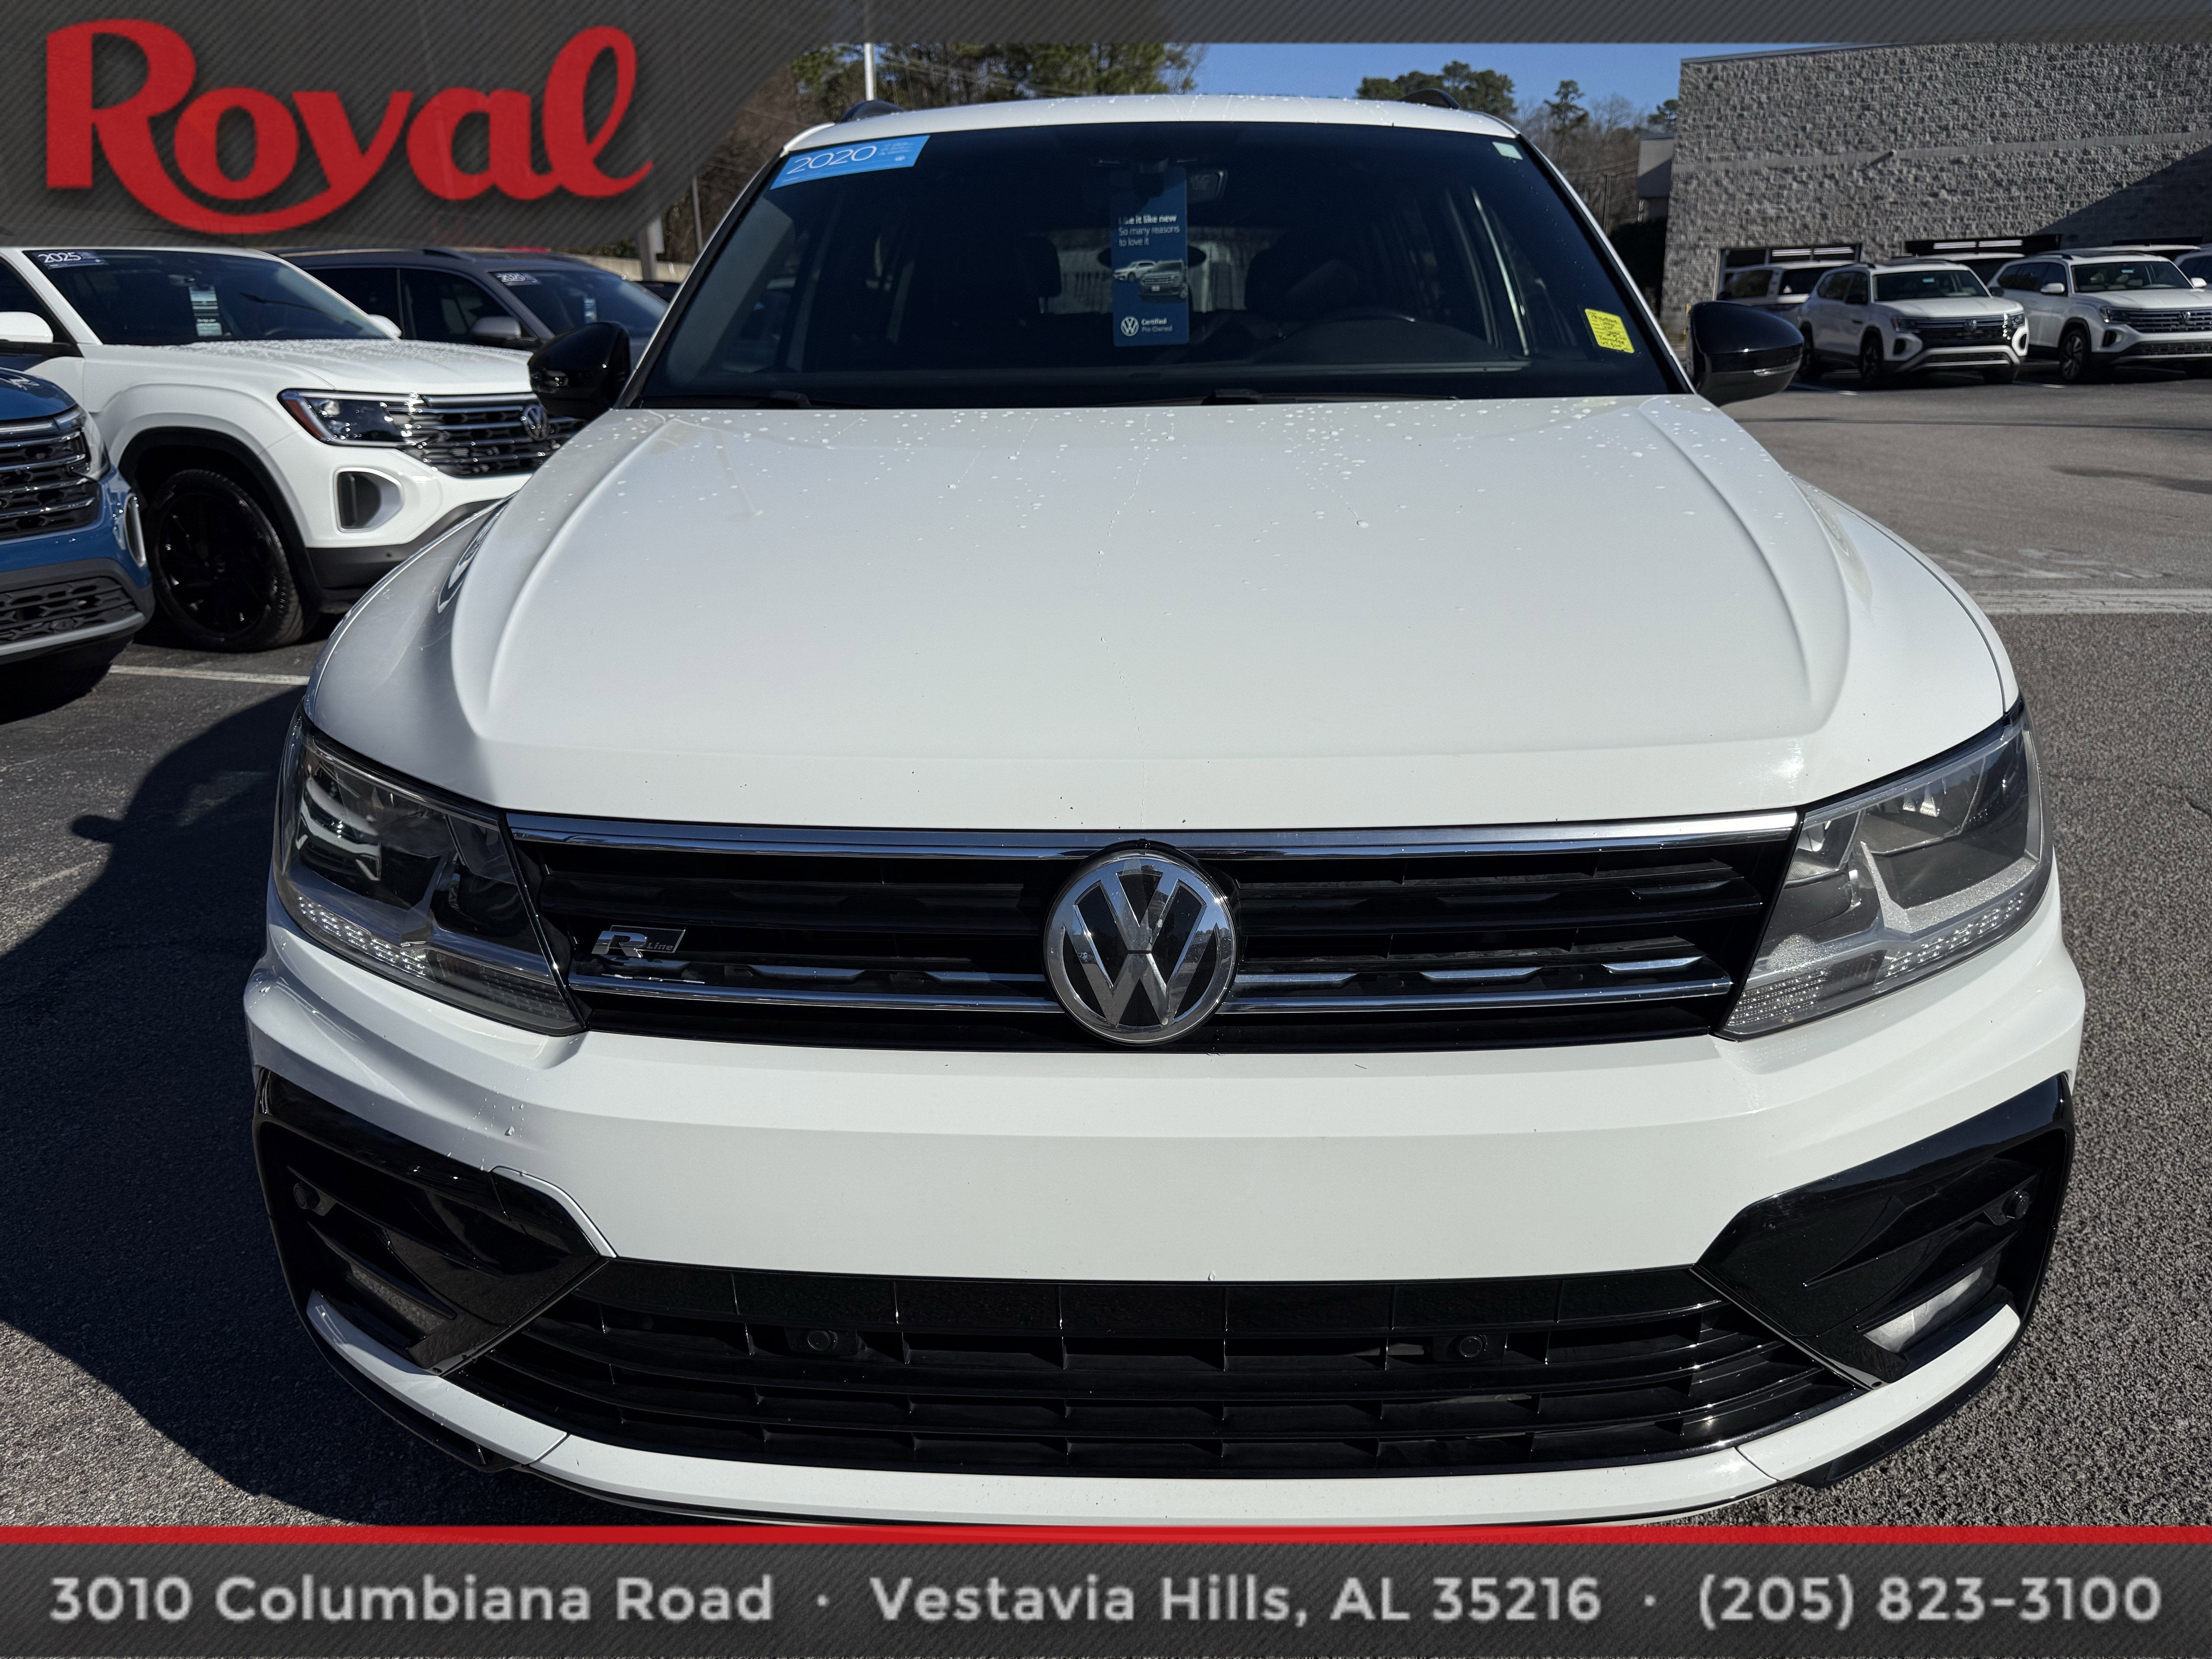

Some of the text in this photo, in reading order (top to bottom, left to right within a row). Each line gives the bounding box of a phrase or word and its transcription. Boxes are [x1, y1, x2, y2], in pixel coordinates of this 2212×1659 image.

[786, 146, 878, 175] 2020
[1143, 214, 1158, 223] like
[1159, 214, 1177, 223] new
[1118, 226, 1180, 237] So many reasons
[1119, 236, 1149, 247] to love it
[38, 252, 81, 263] 2025
[646, 942, 673, 951] Line
